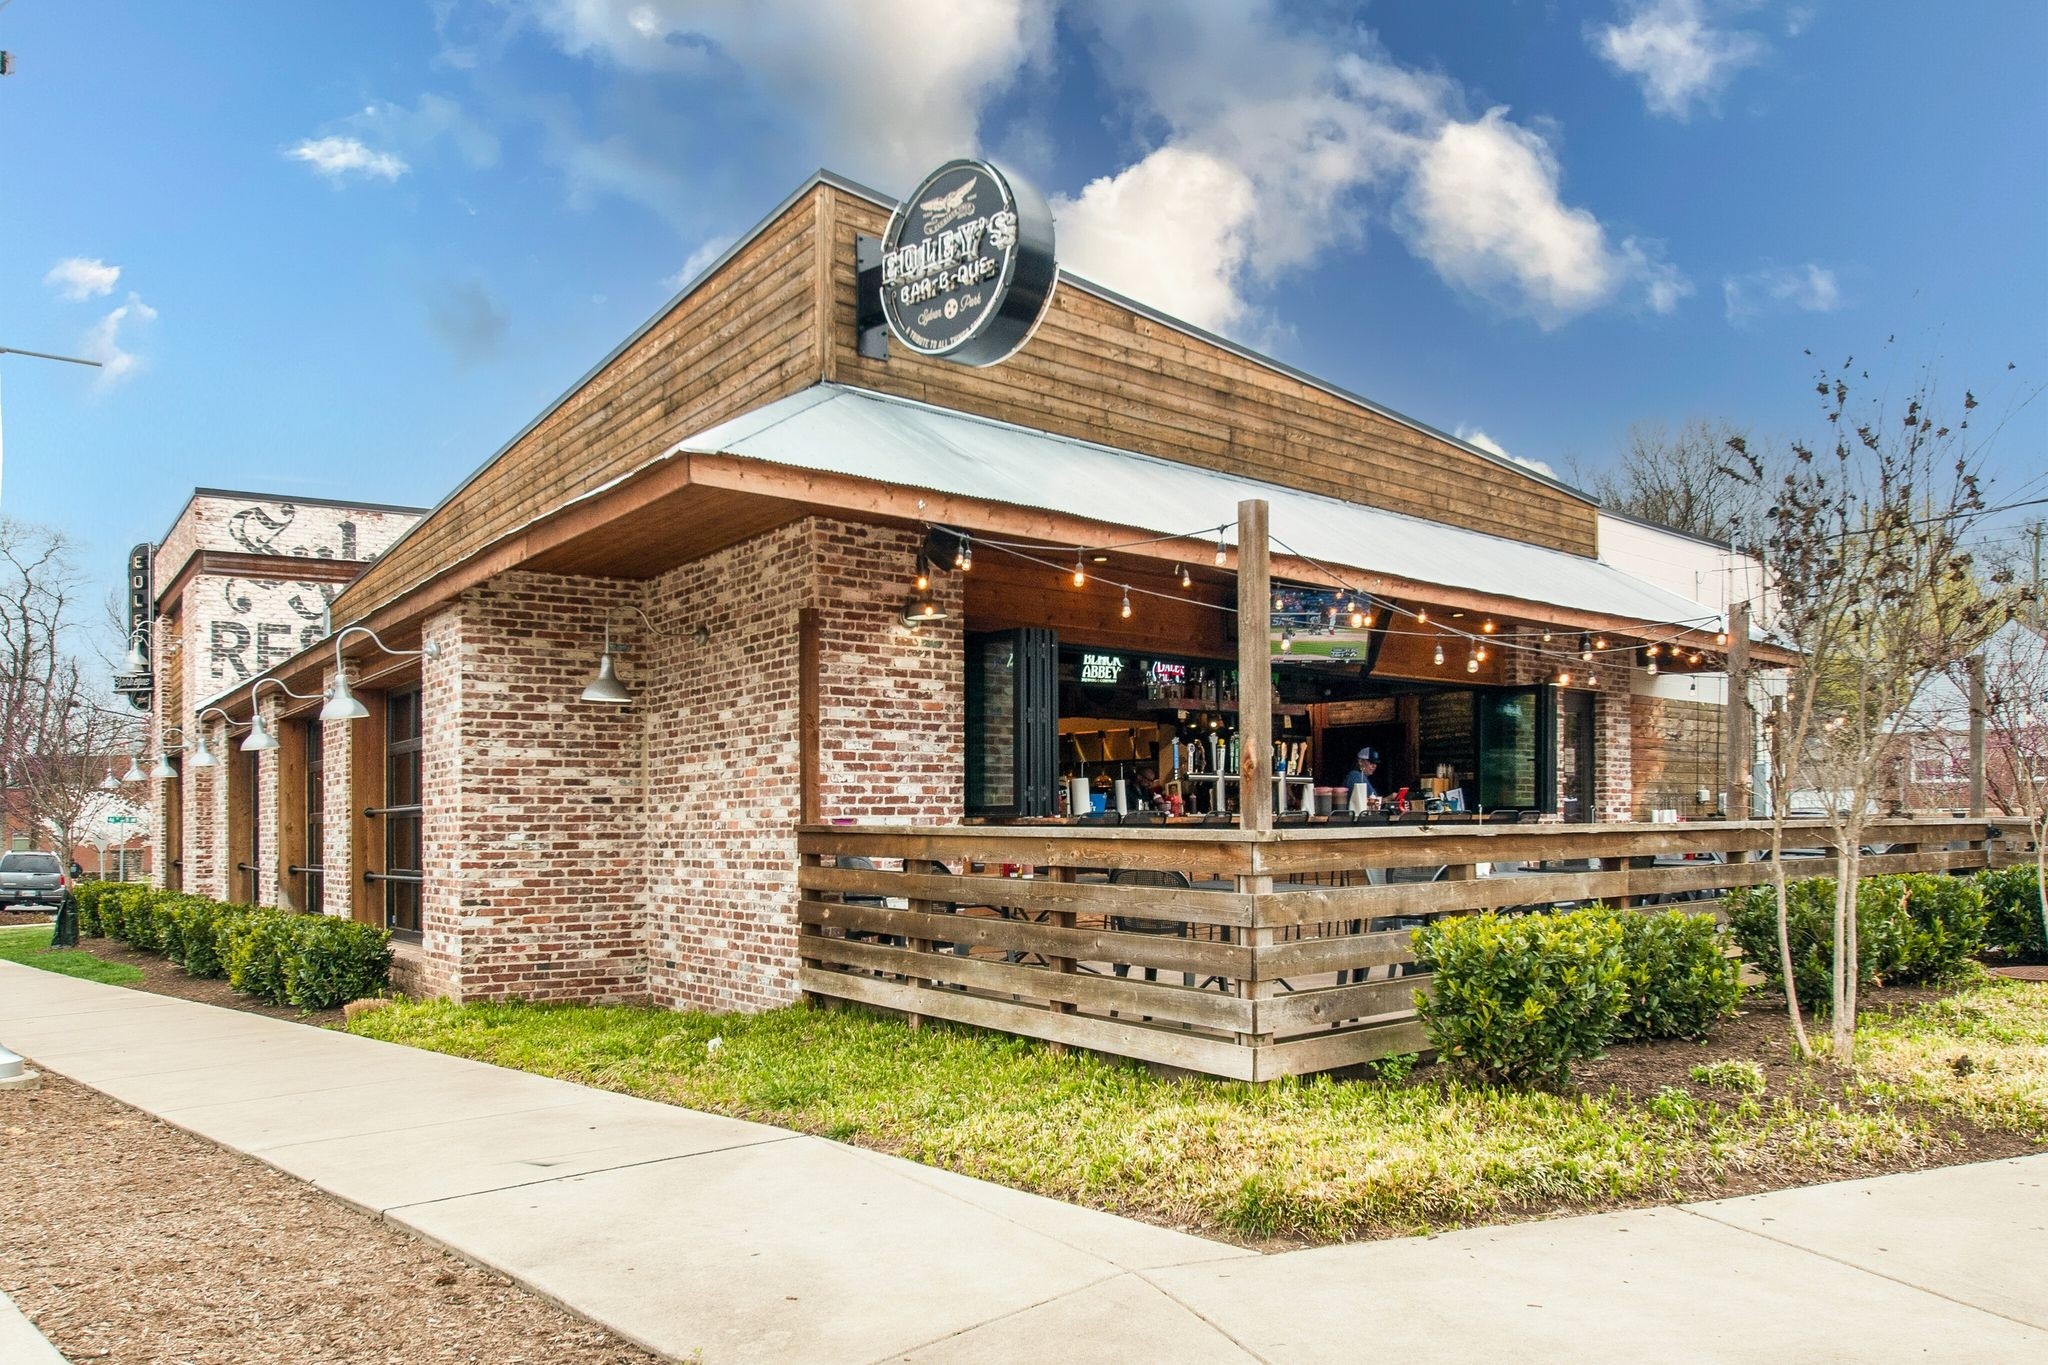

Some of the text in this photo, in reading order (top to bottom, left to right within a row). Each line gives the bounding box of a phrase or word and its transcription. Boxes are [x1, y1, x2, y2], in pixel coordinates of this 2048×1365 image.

[881, 211, 1017, 285] EDLEY'S
[900, 257, 996, 306] BAR-B-QUE
[930, 339, 938, 349] TO
[938, 338, 948, 348] ALL
[1082, 665, 1121, 679] ABBEY
